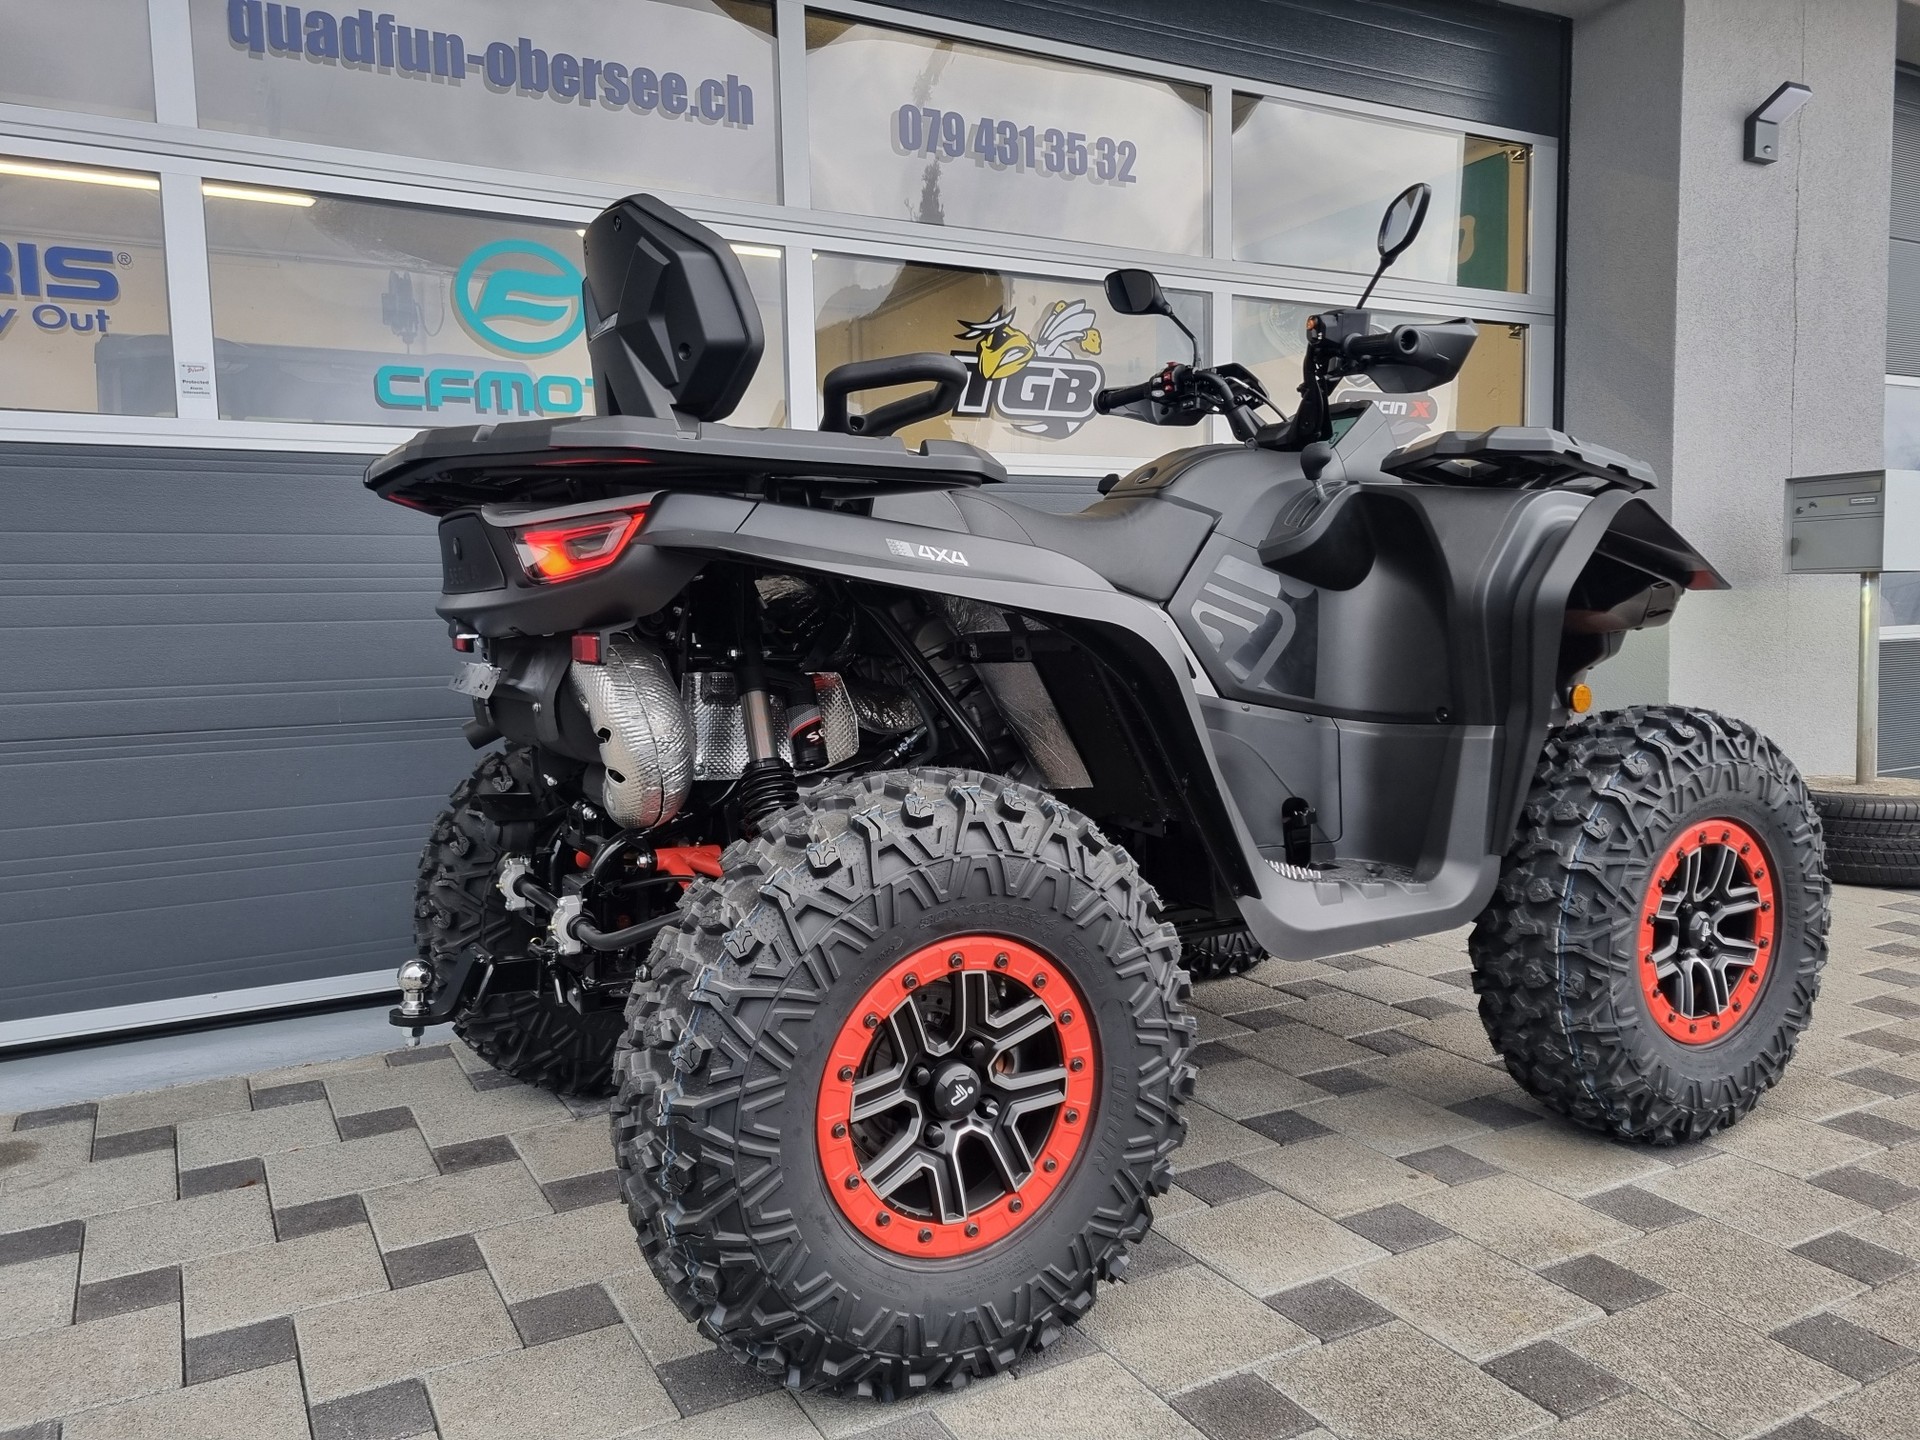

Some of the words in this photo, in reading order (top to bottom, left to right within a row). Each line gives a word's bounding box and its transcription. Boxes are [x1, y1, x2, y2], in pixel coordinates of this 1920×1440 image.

[228, 0, 754, 126] quadfun-obersee.ch
[899, 104, 965, 158] 079
[974, 117, 1036, 169] 431
[1044, 128, 1088, 176] 35
[1096, 136, 1137, 184] 32
[0, 242, 119, 302] IS
[32, 304, 110, 332] Out
[377, 365, 593, 413] CFMO
[950, 350, 1105, 418] TGB
[1409, 401, 1431, 418] X
[918, 544, 969, 567] 4X4
